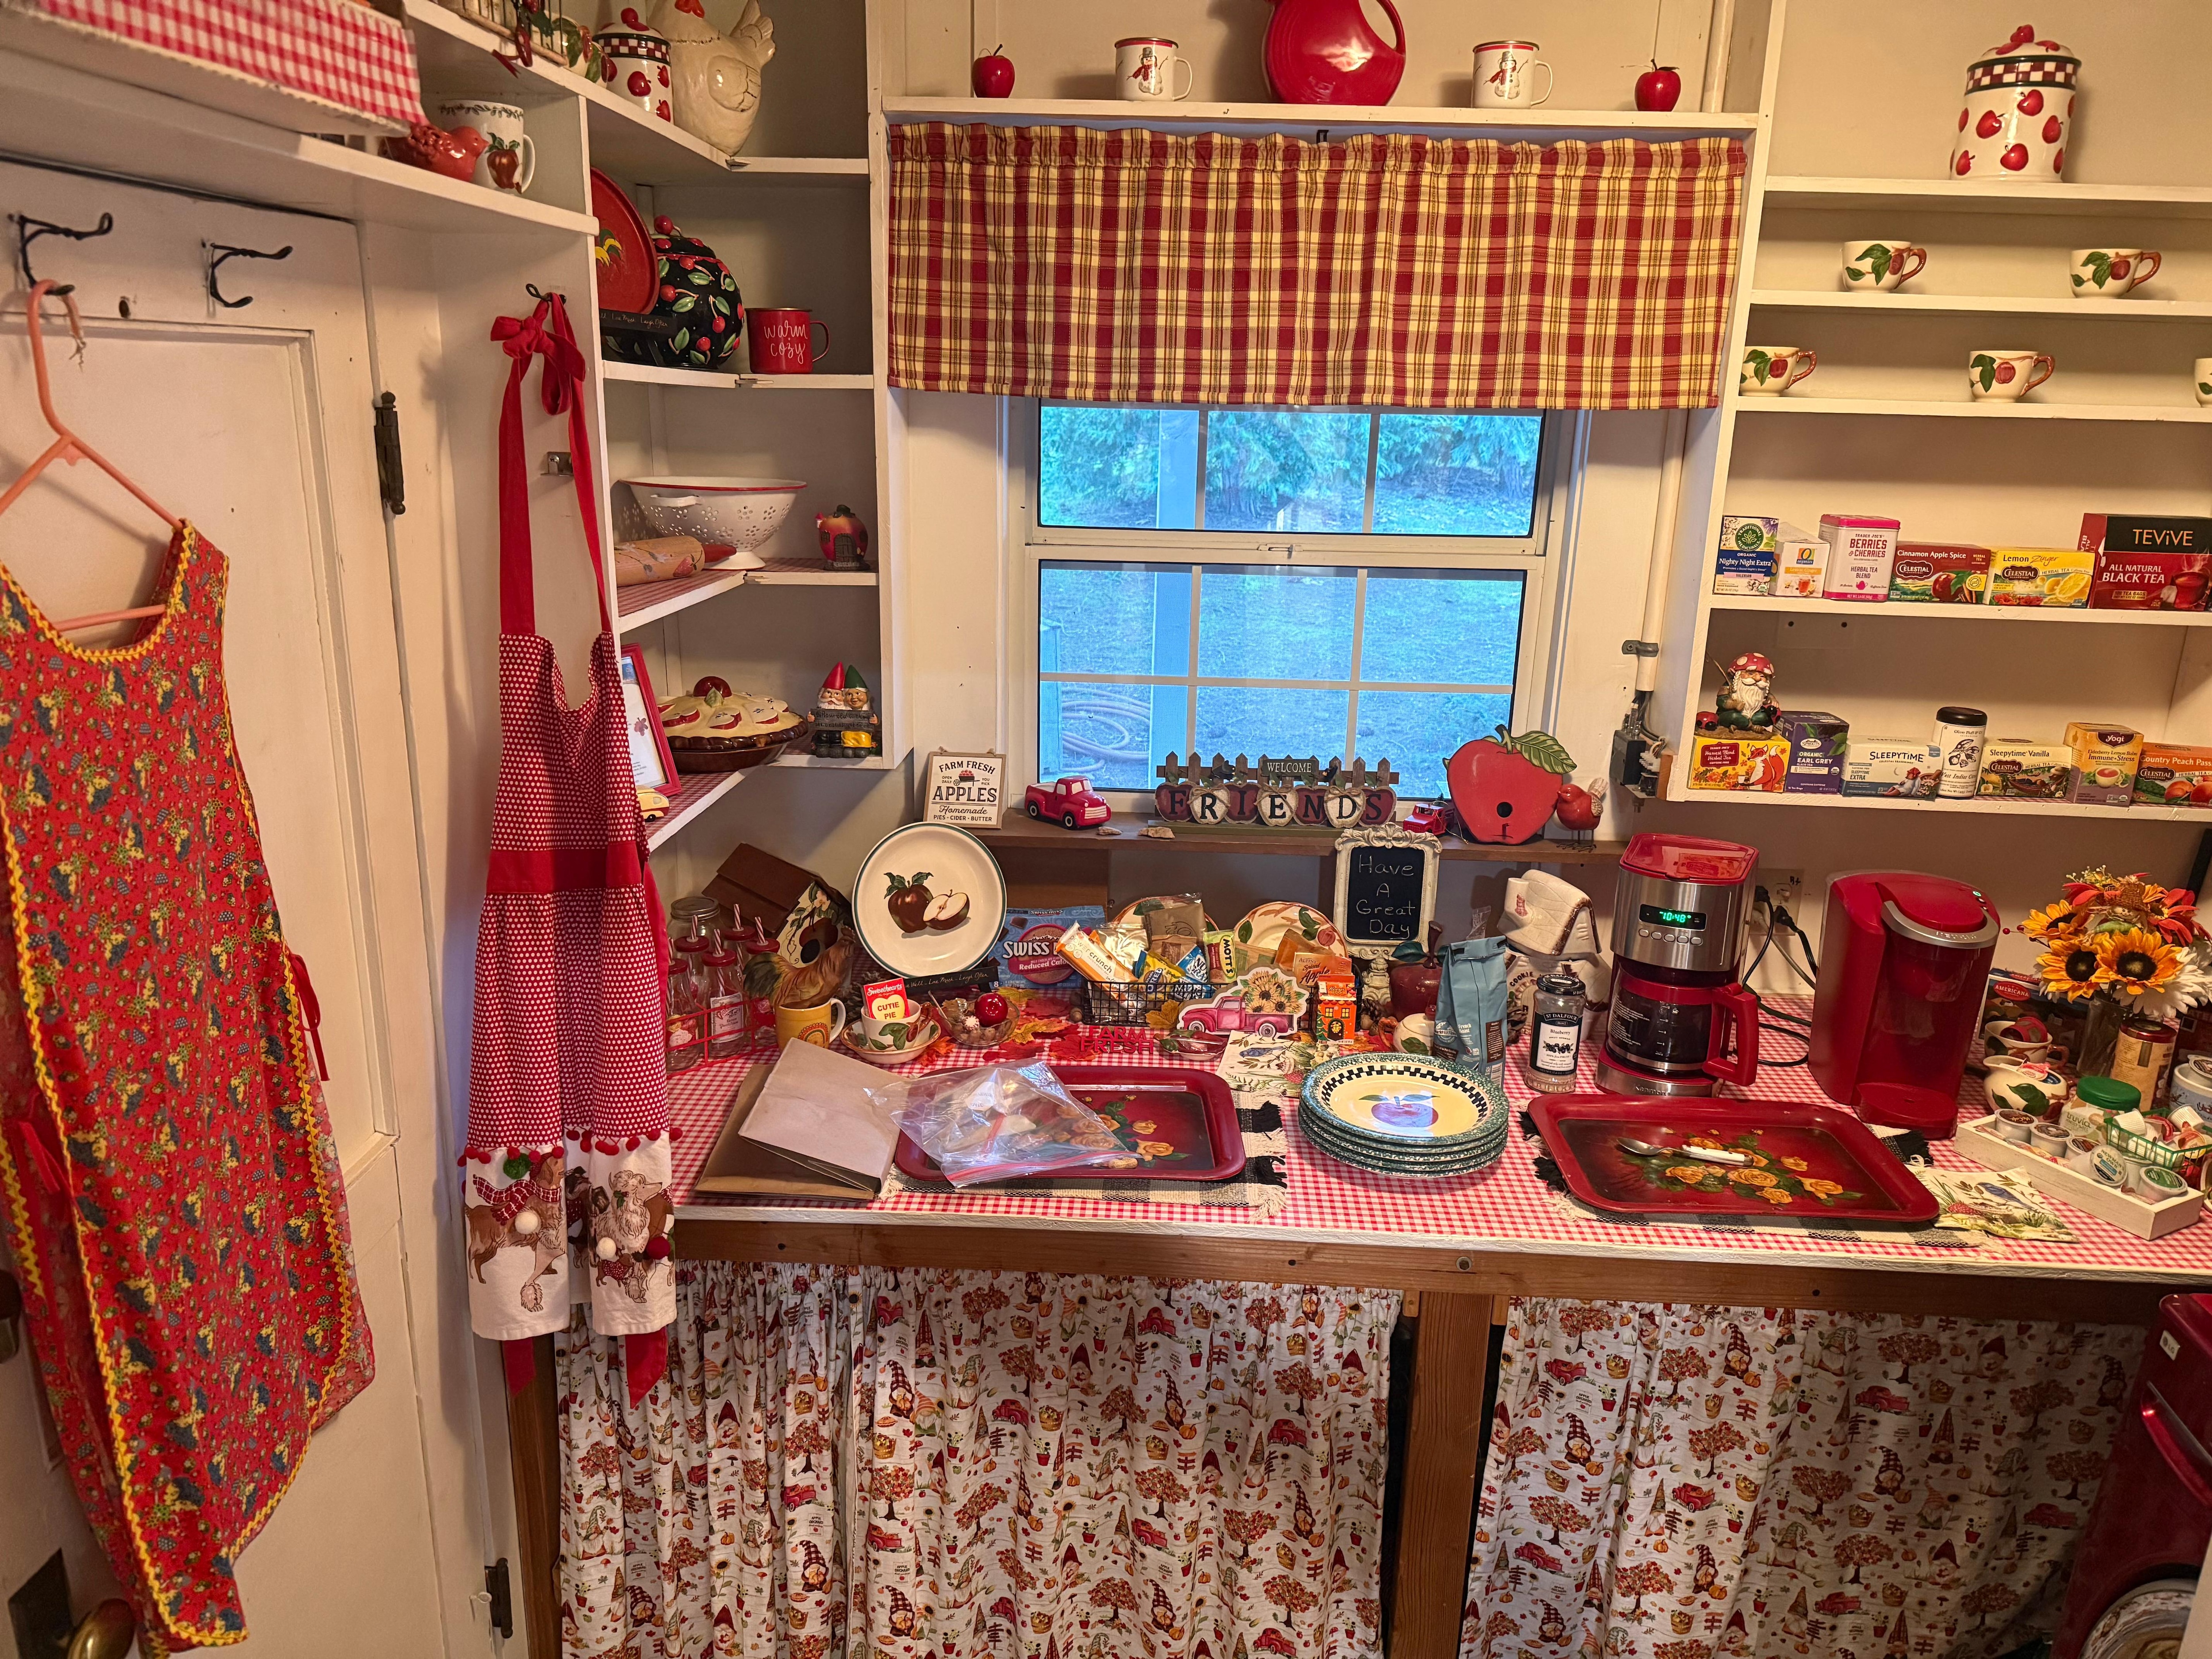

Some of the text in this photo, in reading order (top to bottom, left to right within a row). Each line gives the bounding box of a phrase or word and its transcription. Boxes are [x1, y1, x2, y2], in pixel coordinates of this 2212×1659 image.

[764, 320, 807, 339] warm
[771, 342, 805, 364] cozy
[1738, 526, 1762, 536] TRADITIONAL
[1737, 540, 1761, 550] MEDICINALS
[1850, 538, 1887, 549] BERRIES
[1740, 558, 1755, 567] Night
[2030, 555, 2059, 566] Zinger
[2005, 568, 2035, 577] CELESTIAL
[2102, 572, 2164, 584] BLACK TEA
[2106, 735, 2124, 743] yogi
[2140, 755, 2170, 764] Country
[939, 761, 995, 774] FARM FRESH
[1267, 762, 1312, 773] WELCOME
[2140, 769, 2171, 778] CELESTIAL
[933, 786, 997, 802] APPLES
[939, 805, 987, 814] Homemade
[1168, 789, 1383, 821] FRIENDS
[1359, 854, 1414, 876] Have
[1376, 883, 1389, 898] A
[1356, 899, 1416, 915] Great
[1370, 919, 1410, 939] Day
[1002, 941, 1050, 959] SWISS
[1090, 952, 1112, 973] crunch
[1223, 939, 1233, 974] MOTT'S
[1019, 961, 1049, 970] Reduced
[1303, 963, 1320, 971] Spiced
[974, 972, 988, 981] Often
[1300, 967, 1330, 984] Apple
[1509, 972, 1534, 987] COOKIE
[867, 984, 902, 996] Sweethearts
[1995, 984, 2029, 997] AMERICANA
[878, 1002, 899, 1011] CUTIE
[1089, 1026, 1147, 1040] FARM
[1080, 1037, 1154, 1054] FRESH
[2168, 1344, 2175, 1354] LG
[1576, 1395, 1592, 1404] ORCHARD
